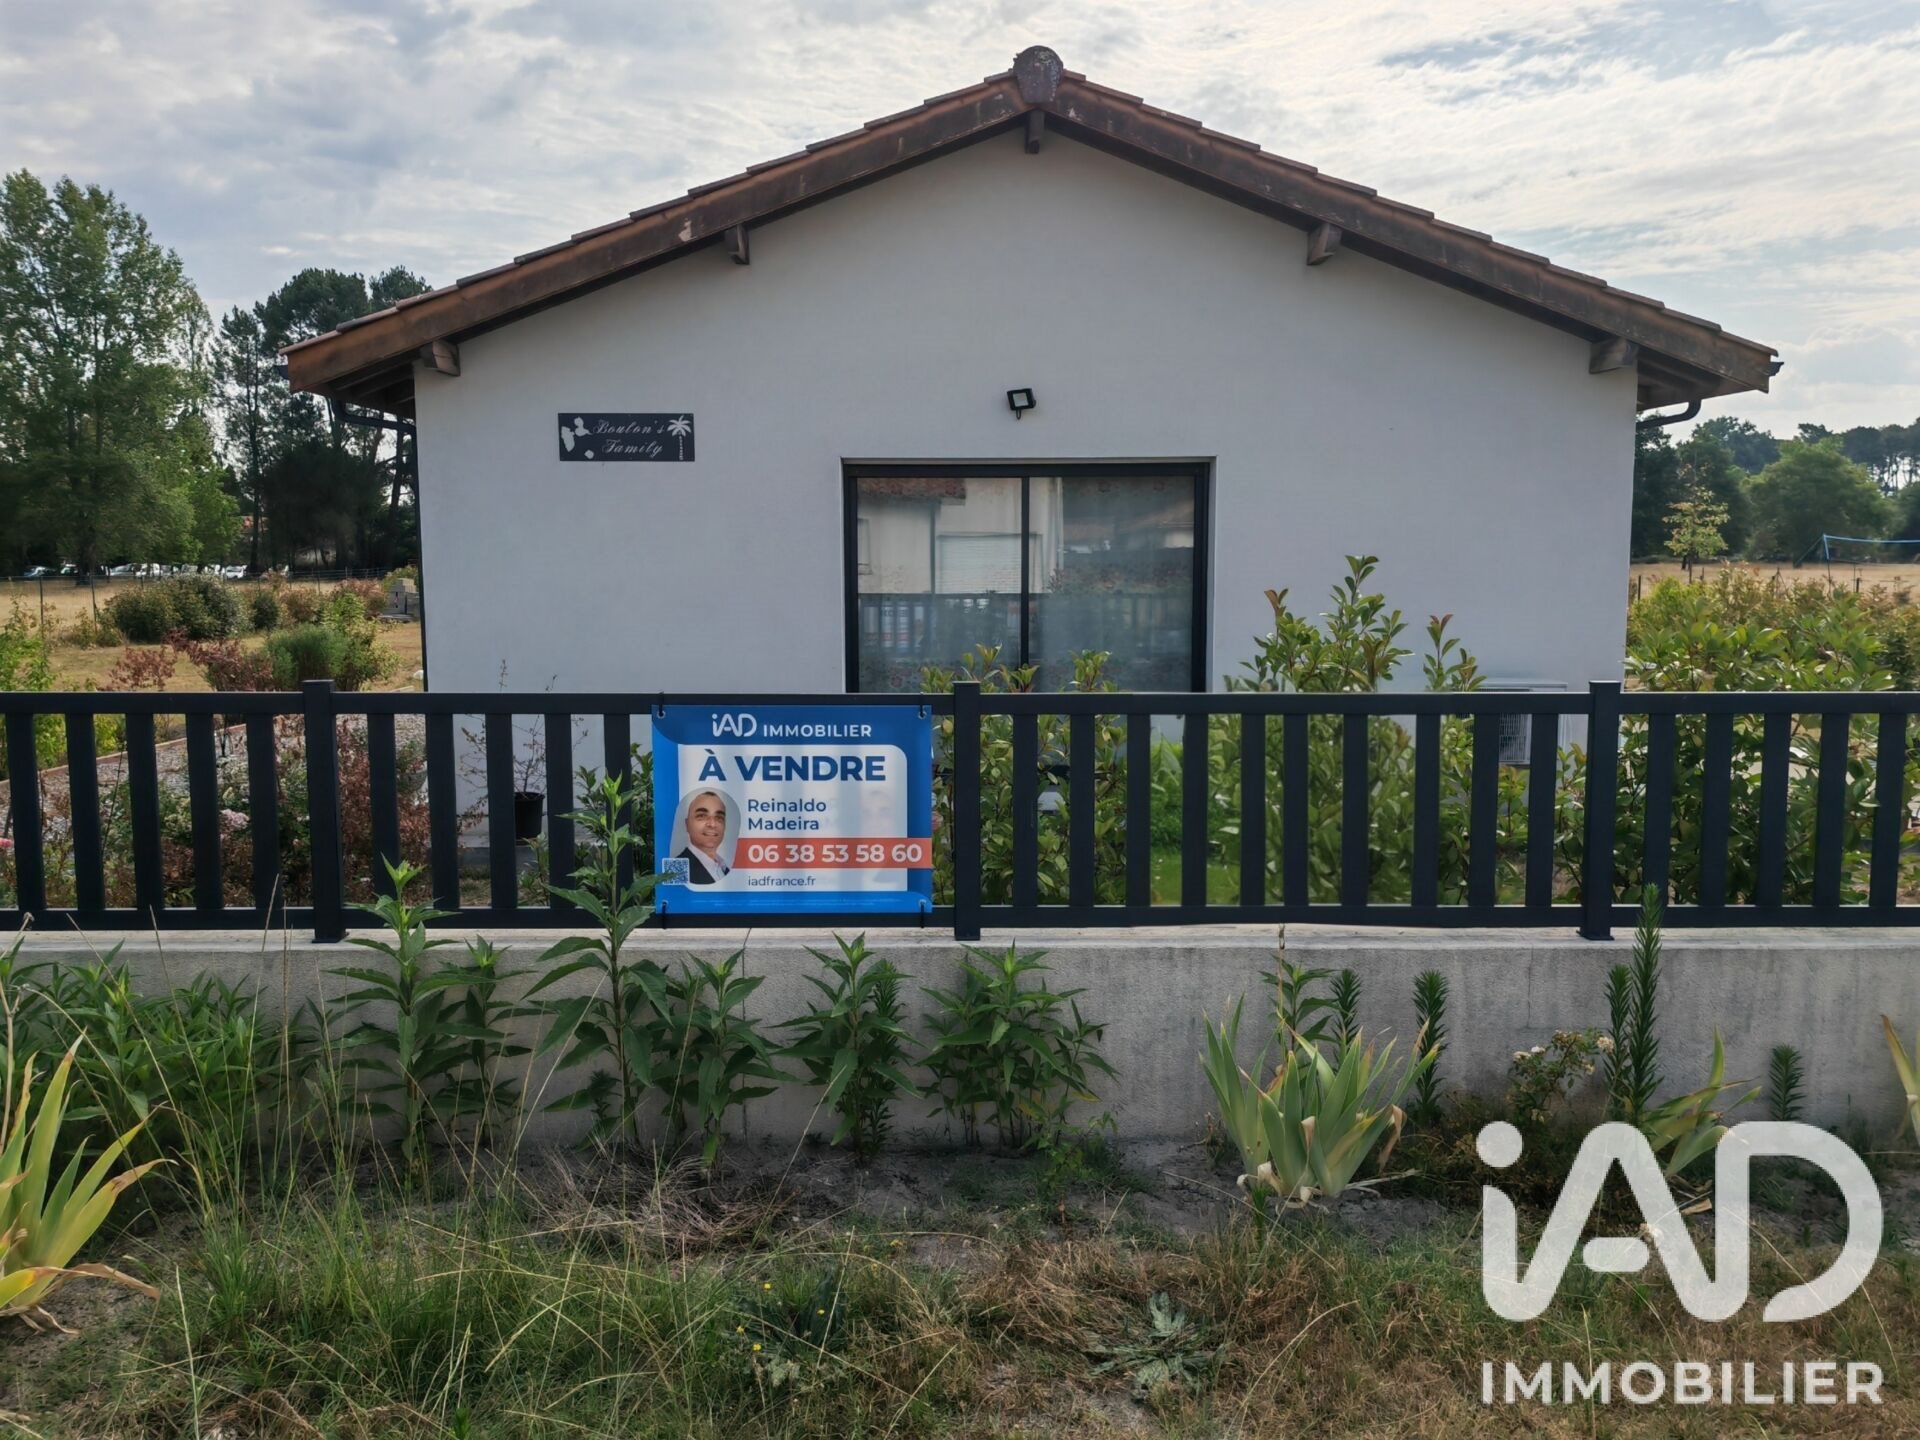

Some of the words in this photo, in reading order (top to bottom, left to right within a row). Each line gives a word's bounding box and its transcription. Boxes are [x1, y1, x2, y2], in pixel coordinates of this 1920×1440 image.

[602, 439, 663, 458] Family
[763, 724, 872, 737] IMMOBILIER
[698, 749, 726, 782] À
[735, 755, 886, 782] VENDRE
[748, 799, 826, 812] Reinaldo
[748, 817, 819, 830] Madeira
[748, 844, 780, 863] 06
[785, 844, 815, 863] 38
[821, 844, 849, 863] 53
[856, 844, 884, 863] 58
[891, 844, 922, 863] 60
[748, 875, 816, 887] iadfrance.fr
